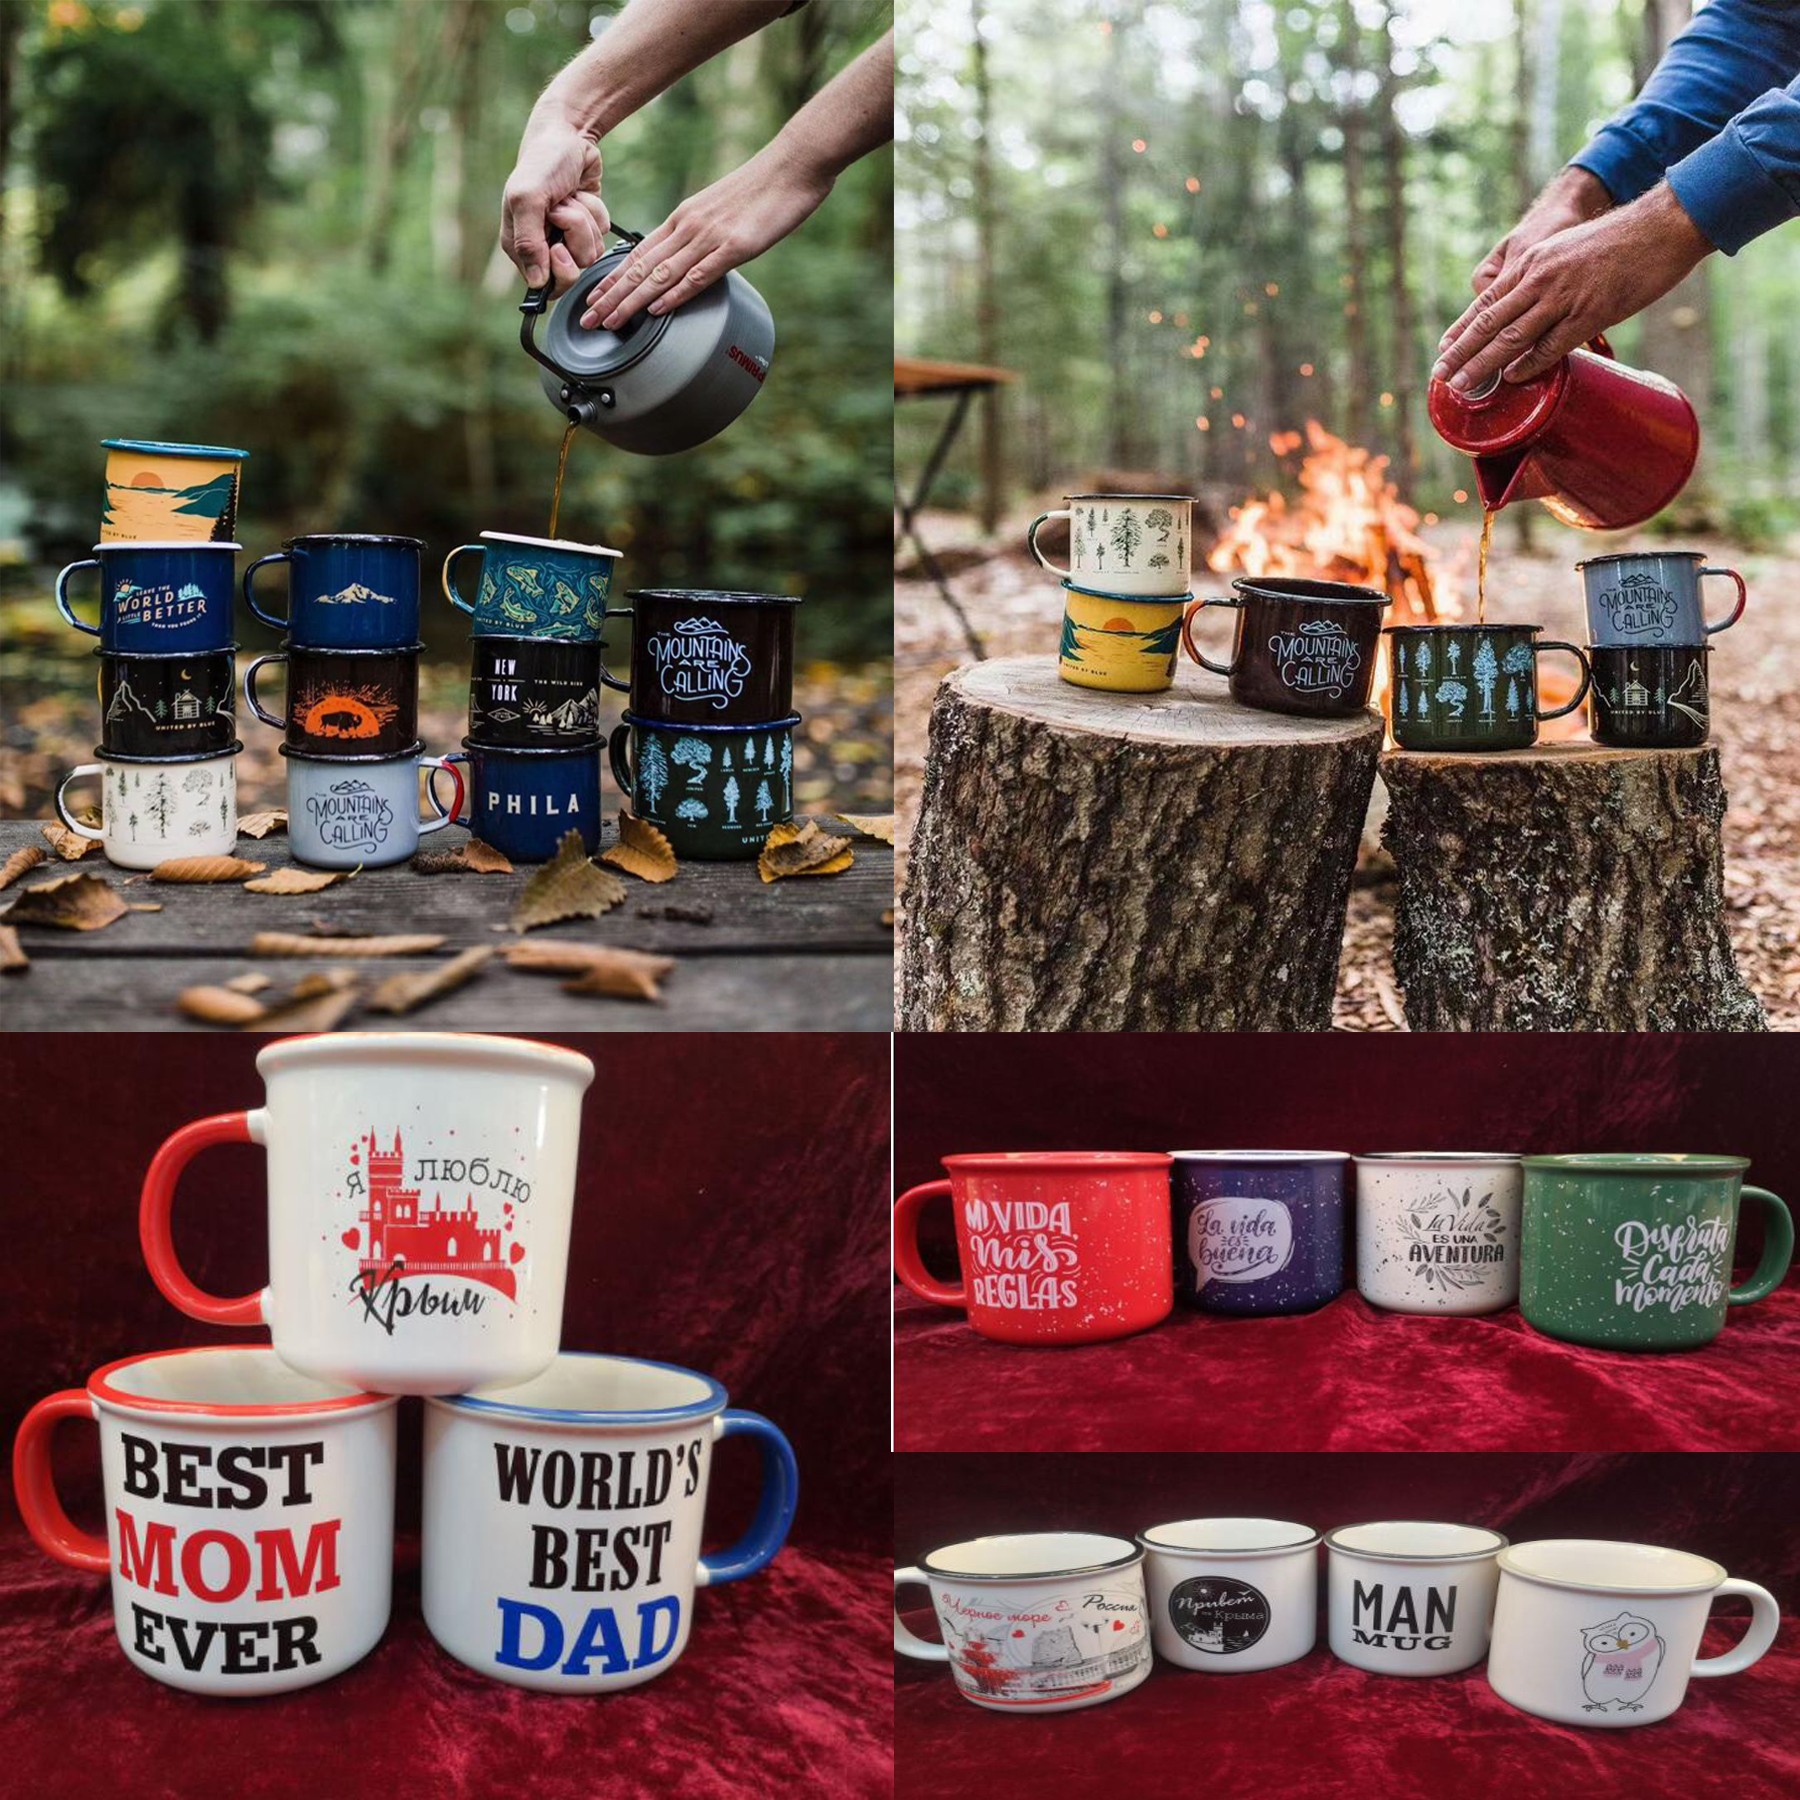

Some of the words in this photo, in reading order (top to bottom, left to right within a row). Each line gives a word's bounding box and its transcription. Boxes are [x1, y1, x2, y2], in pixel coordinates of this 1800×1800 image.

[729, 345, 766, 384] PRIMUS
[118, 591, 174, 613] WORLD
[142, 599, 207, 622] BETTER
[1598, 586, 1678, 618] MOUNTAINS
[1624, 603, 1656, 612] ARE
[1612, 610, 1674, 632] CALLING
[494, 659, 516, 676] NEW
[648, 635, 752, 677] MOUNTAINS
[678, 659, 720, 672] ARE
[1268, 636, 1360, 670] MOUNTAINS
[1300, 656, 1338, 668] ARE
[661, 664, 744, 698] CALLING
[1282, 660, 1354, 688] CALLING
[492, 684, 518, 702] YORK
[306, 794, 394, 826] MOUNTAINS
[488, 791, 580, 815] PHILA
[320, 818, 388, 845] CALLING
[336, 815, 368, 825] ARE
[346, 1170, 366, 1198] Я
[990, 1201, 1072, 1236] VIDA
[1409, 1244, 1504, 1264] AVENTURA
[1432, 1234, 1450, 1244] ES
[1453, 1235, 1478, 1244] UNA
[1642, 1250, 1713, 1287] Cada
[349, 1260, 486, 1336] Крым
[973, 1273, 1078, 1310] REGLAS
[121, 1432, 324, 1510] BEST
[494, 1438, 702, 1511] WORLD'S
[115, 1506, 342, 1604] MOM
[529, 1520, 672, 1592] BEST
[1007, 1614, 1052, 1628] море
[1082, 1594, 1138, 1612] Россия
[1176, 1591, 1255, 1616] Привет
[1214, 1610, 1265, 1622] Крыма
[1353, 1579, 1458, 1635] MAN
[131, 1601, 322, 1674] EVER
[495, 1594, 681, 1676] DAD
[1352, 1628, 1454, 1651] MUG
